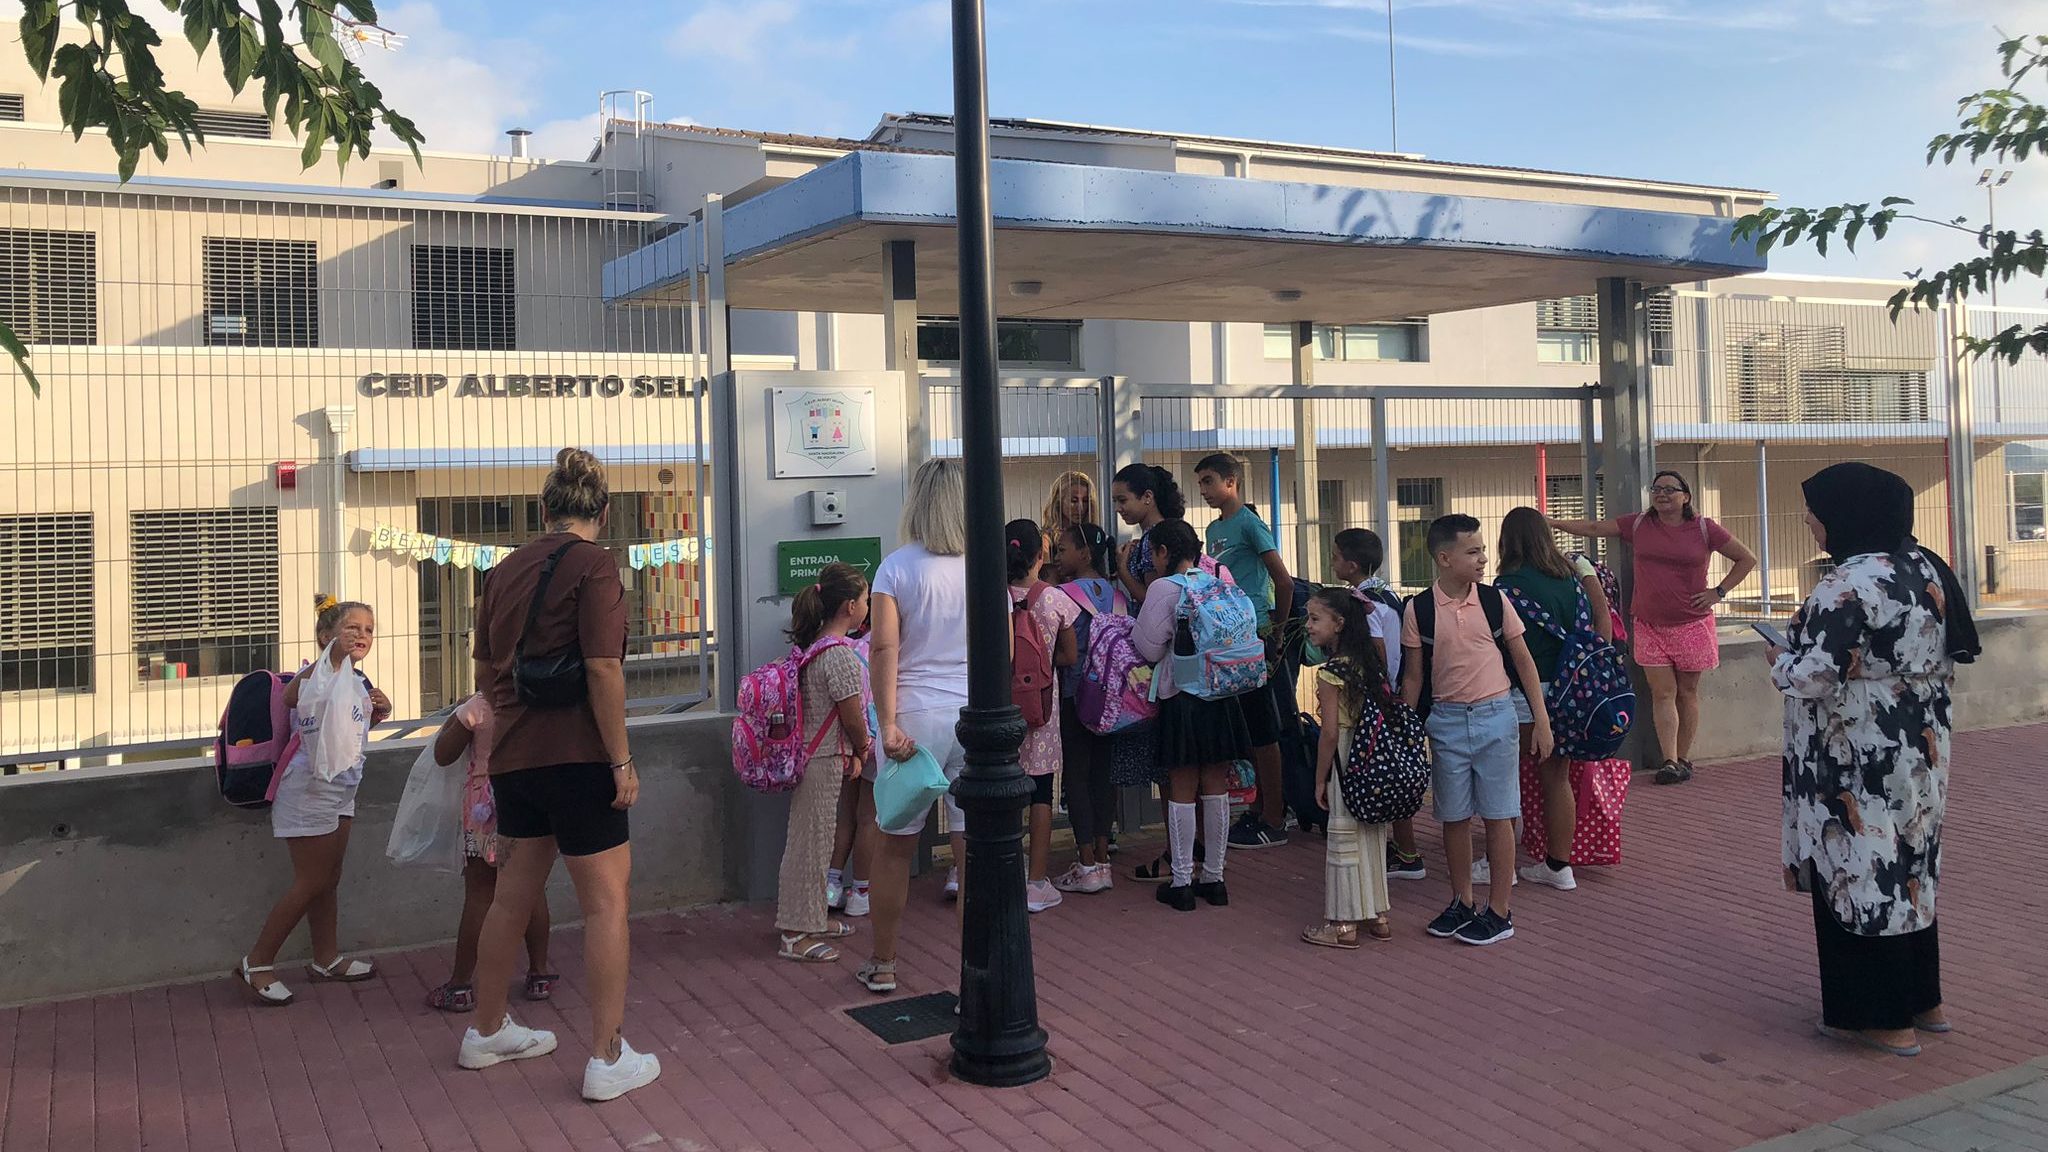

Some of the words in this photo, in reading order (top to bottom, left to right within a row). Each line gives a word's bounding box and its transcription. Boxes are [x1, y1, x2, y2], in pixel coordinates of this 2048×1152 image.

[357, 372, 448, 398] CEIP
[454, 374, 624, 398] ALBERTO
[789, 555, 840, 566] ENTRADA
